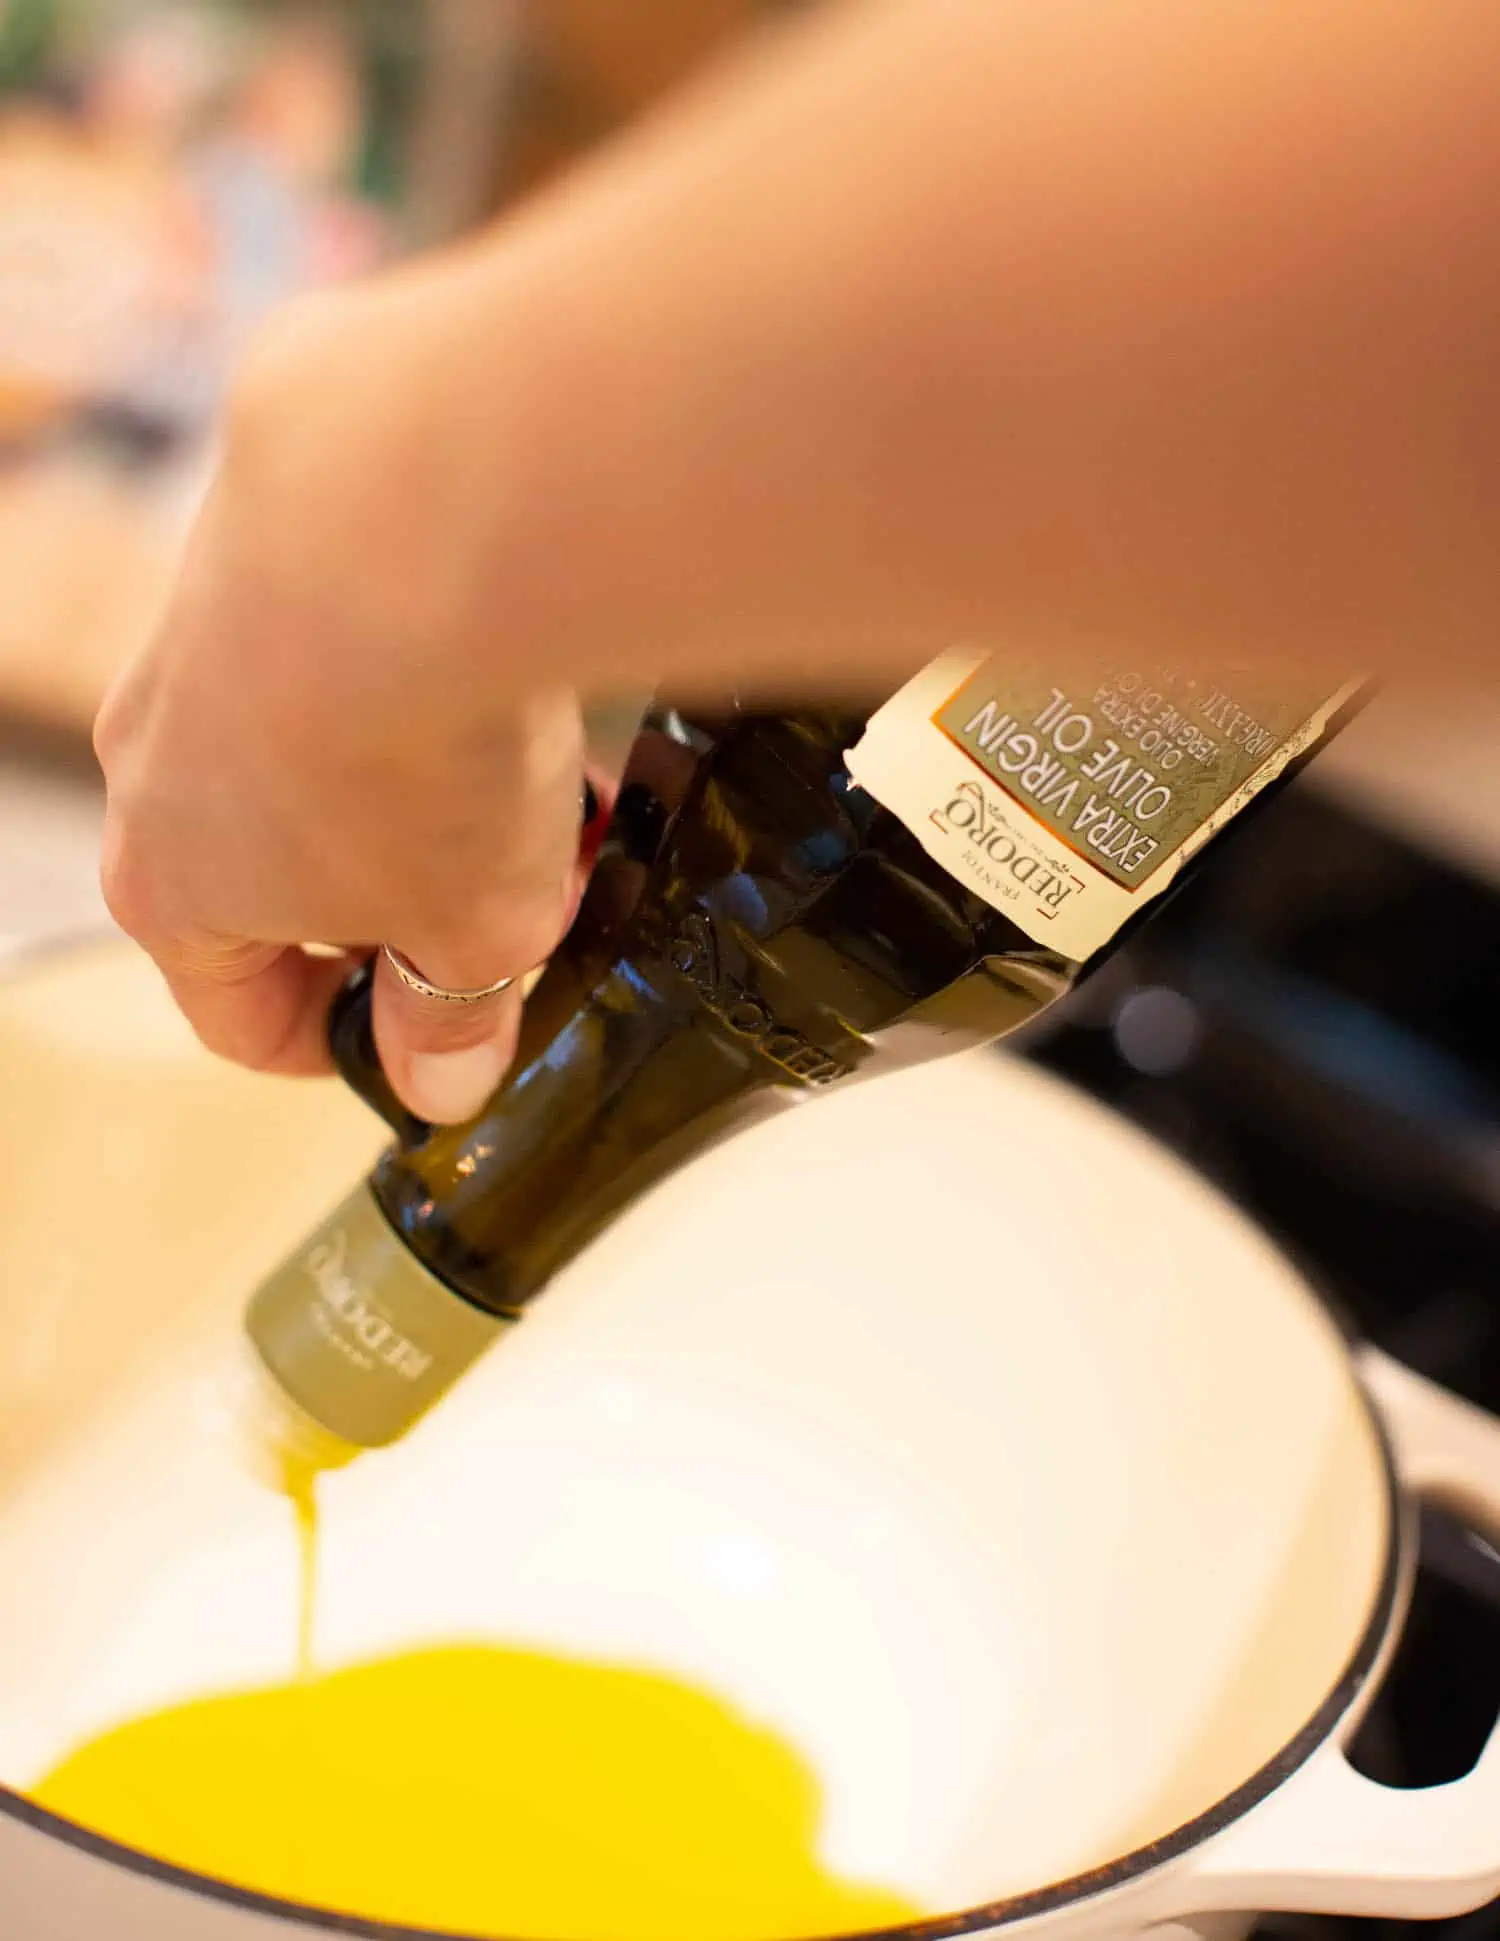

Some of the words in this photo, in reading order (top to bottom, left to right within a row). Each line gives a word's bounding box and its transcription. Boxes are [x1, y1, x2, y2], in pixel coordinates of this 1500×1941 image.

[1032, 687, 1093, 753] OIL
[1092, 687, 1147, 739] EXTRA
[1152, 703, 1219, 767] VERGINE
[963, 699, 1081, 818] VIRGIN
[1080, 739, 1171, 820] OLIVE
[1139, 729, 1184, 770] OLIO
[945, 782, 1072, 908] REDORO
[1072, 793, 1161, 874] EXTRA
[961, 850, 1021, 901] FRANTOI
